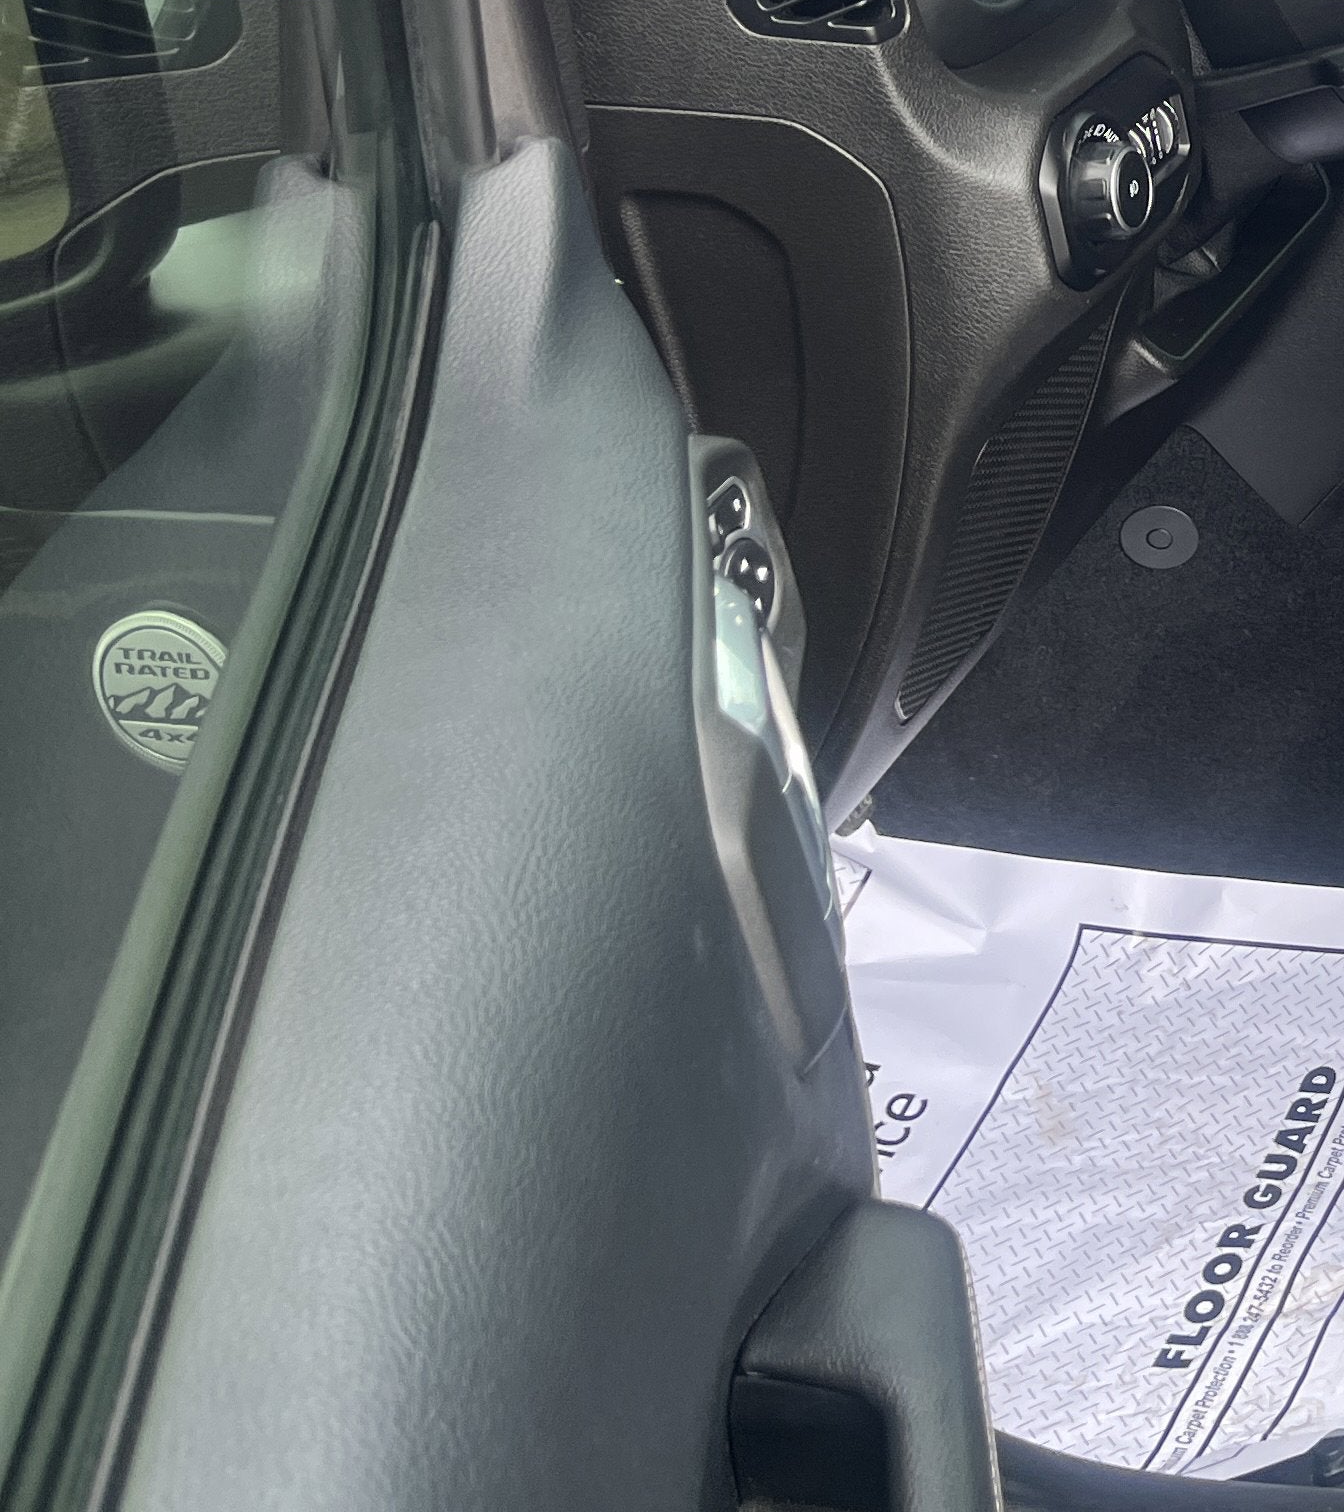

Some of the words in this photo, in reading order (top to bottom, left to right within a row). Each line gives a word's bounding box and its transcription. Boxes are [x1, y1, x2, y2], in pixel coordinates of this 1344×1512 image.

[1103, 128, 1120, 143] AUT
[116, 648, 202, 664] TRAIL
[114, 662, 210, 680] RATED
[1152, 1223, 1264, 1369] FLOOR
[1243, 1066, 1336, 1209] GUARD
[1175, 1407, 1208, 1445] Carpet
[1195, 1355, 1237, 1408] Protection
[1243, 1275, 1278, 1323] 247-5432
[1271, 1226, 1303, 1262] Reorder
[1295, 1180, 1330, 1220] Premium
[1317, 1147, 1344, 1179] Carpet
